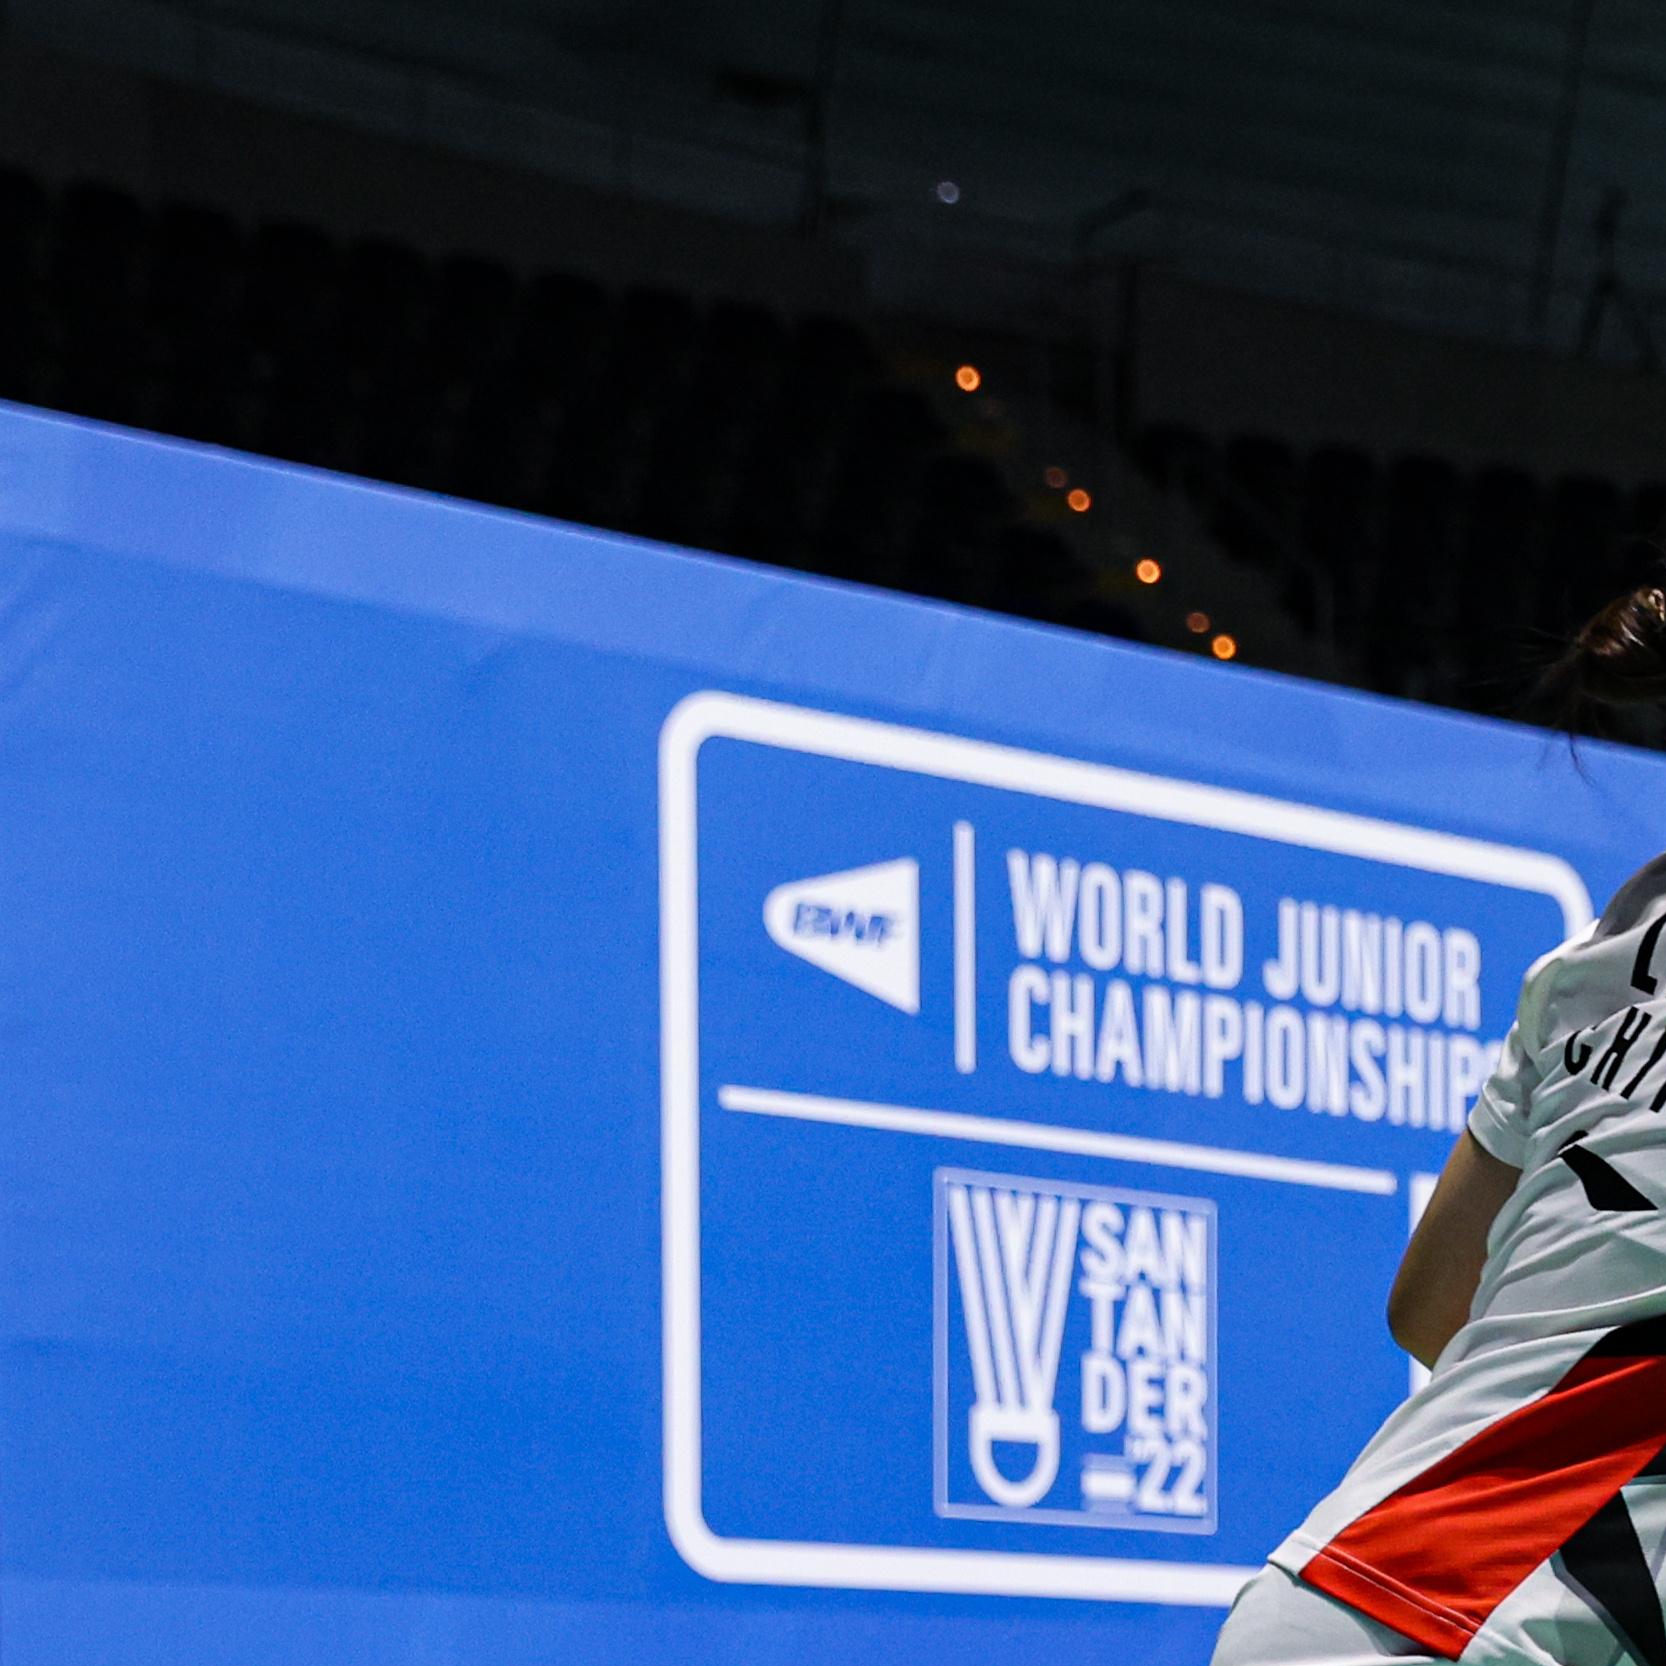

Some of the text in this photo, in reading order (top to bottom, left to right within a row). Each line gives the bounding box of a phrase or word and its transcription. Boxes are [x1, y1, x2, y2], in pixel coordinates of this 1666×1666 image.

[1006, 847, 1482, 1031] WORLD JUNIOR
[1080, 1202, 1207, 1295] SAN
[1079, 1277, 1207, 1365] TAN
[1081, 1352, 1208, 1441] DER
